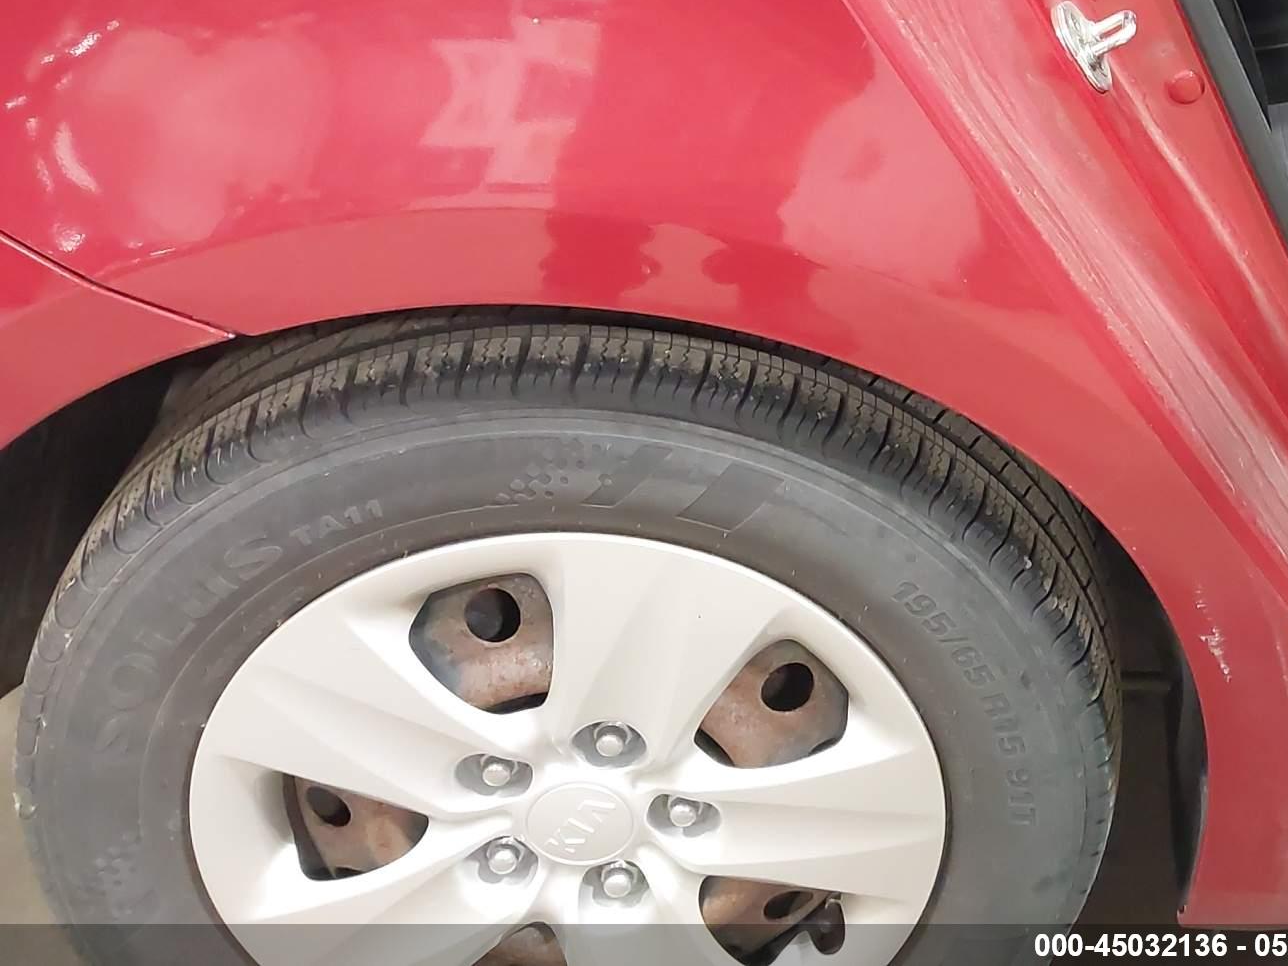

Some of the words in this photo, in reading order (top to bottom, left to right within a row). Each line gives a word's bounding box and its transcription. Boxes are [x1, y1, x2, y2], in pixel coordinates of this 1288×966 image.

[289, 498, 384, 547] TA11
[890, 580, 997, 688] 195/65
[543, 798, 617, 855] KIA
